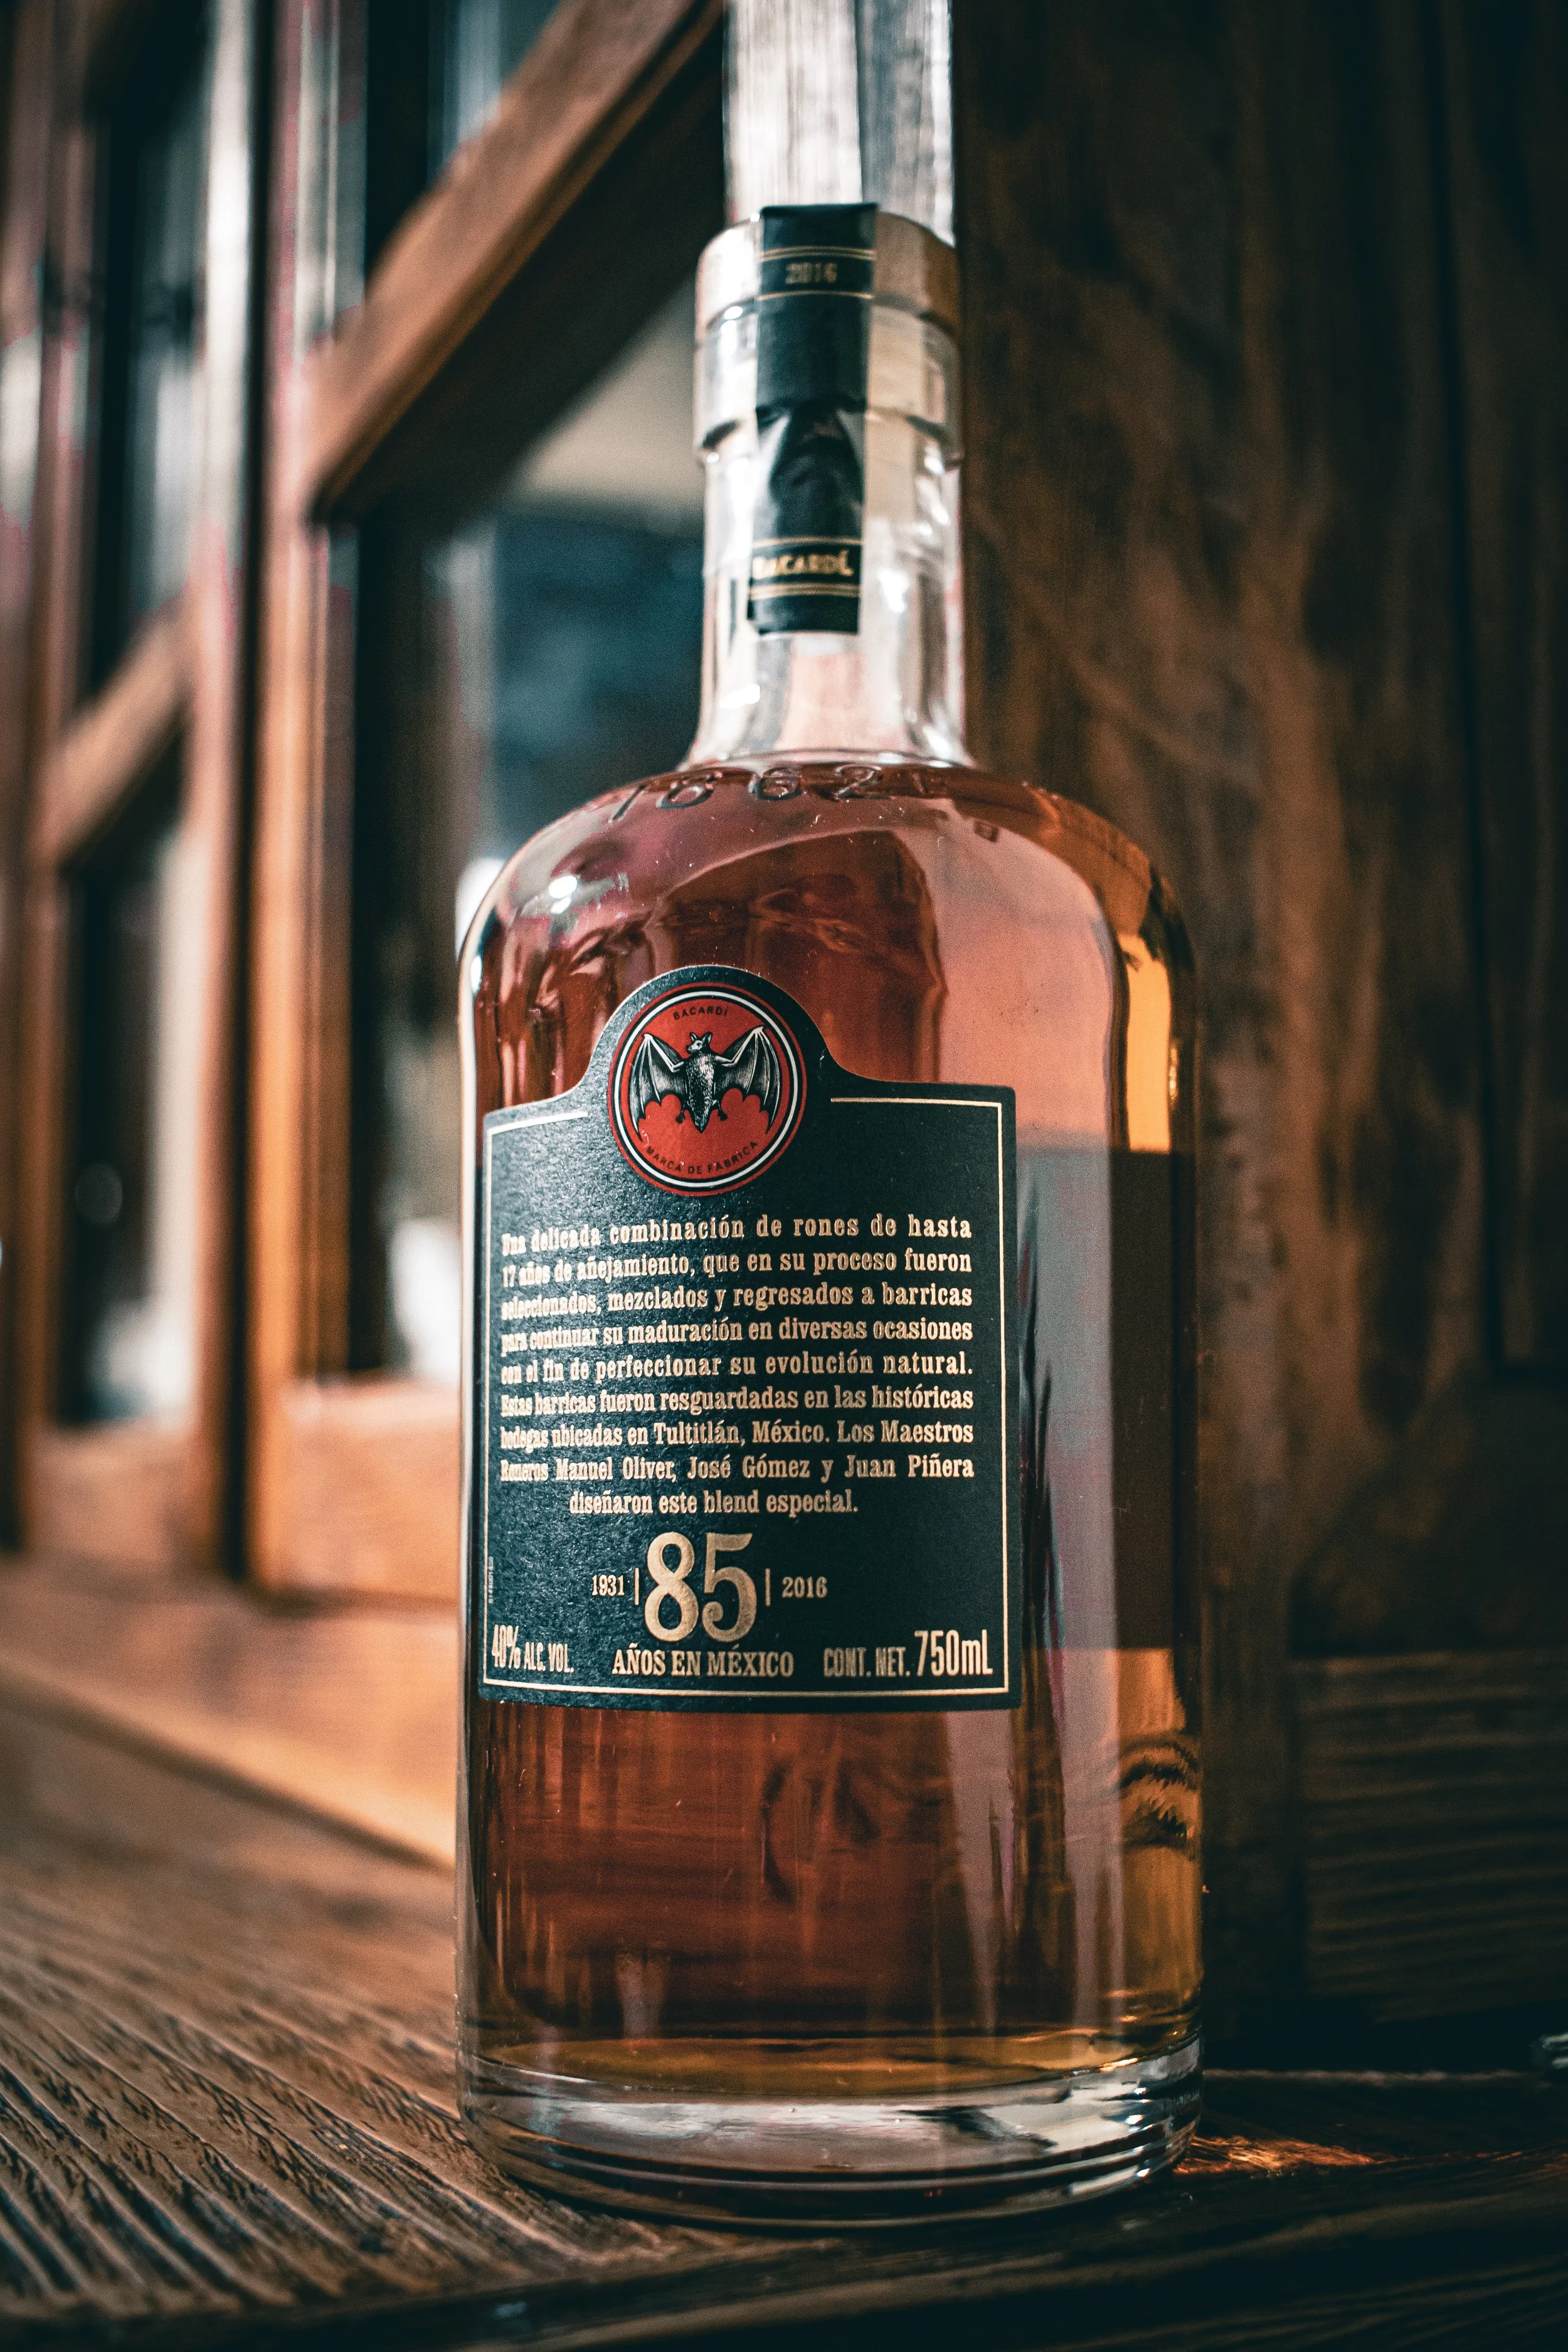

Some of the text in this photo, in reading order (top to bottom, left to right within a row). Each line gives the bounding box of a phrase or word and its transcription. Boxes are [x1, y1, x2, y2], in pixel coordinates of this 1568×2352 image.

[647, 1146, 682, 1172] MARCA
[688, 1165, 702, 1175] DE
[532, 1224, 601, 1252] delicada
[610, 1214, 744, 1244] combinación
[756, 1214, 782, 1237] de
[794, 1218, 859, 1237] rones
[871, 1213, 897, 1237] de
[908, 1214, 972, 1238] hasta
[502, 1247, 972, 1287] 17 años de añejamiento, que en su proceso fueron
[502, 1281, 972, 1320] seleccionados, mezclados y regresados a barricas
[501, 1316, 973, 1357] para continuar su maduración en diversas ocasiones
[501, 1349, 973, 1385] con el fin de perfeccionar su evolución natural.
[501, 1384, 973, 1417] Estas barricas fueron resguardadas en las históricas
[501, 1419, 973, 1453] bodegas ubicadas en Tultitlán, México. Los Maestros
[501, 1453, 974, 1483] Roneros Manuel Oliver, José Gómez y Juan Piñera
[569, 1489, 858, 1518] diseñaron este blend especial.
[591, 1531, 828, 1643] 1931 85 2016
[491, 1624, 574, 1673] 40% ALC. VOL.
[612, 1642, 794, 1677] AÑOS EN MÉXICO
[823, 1629, 993, 1678] CONT. NET. 750mL
